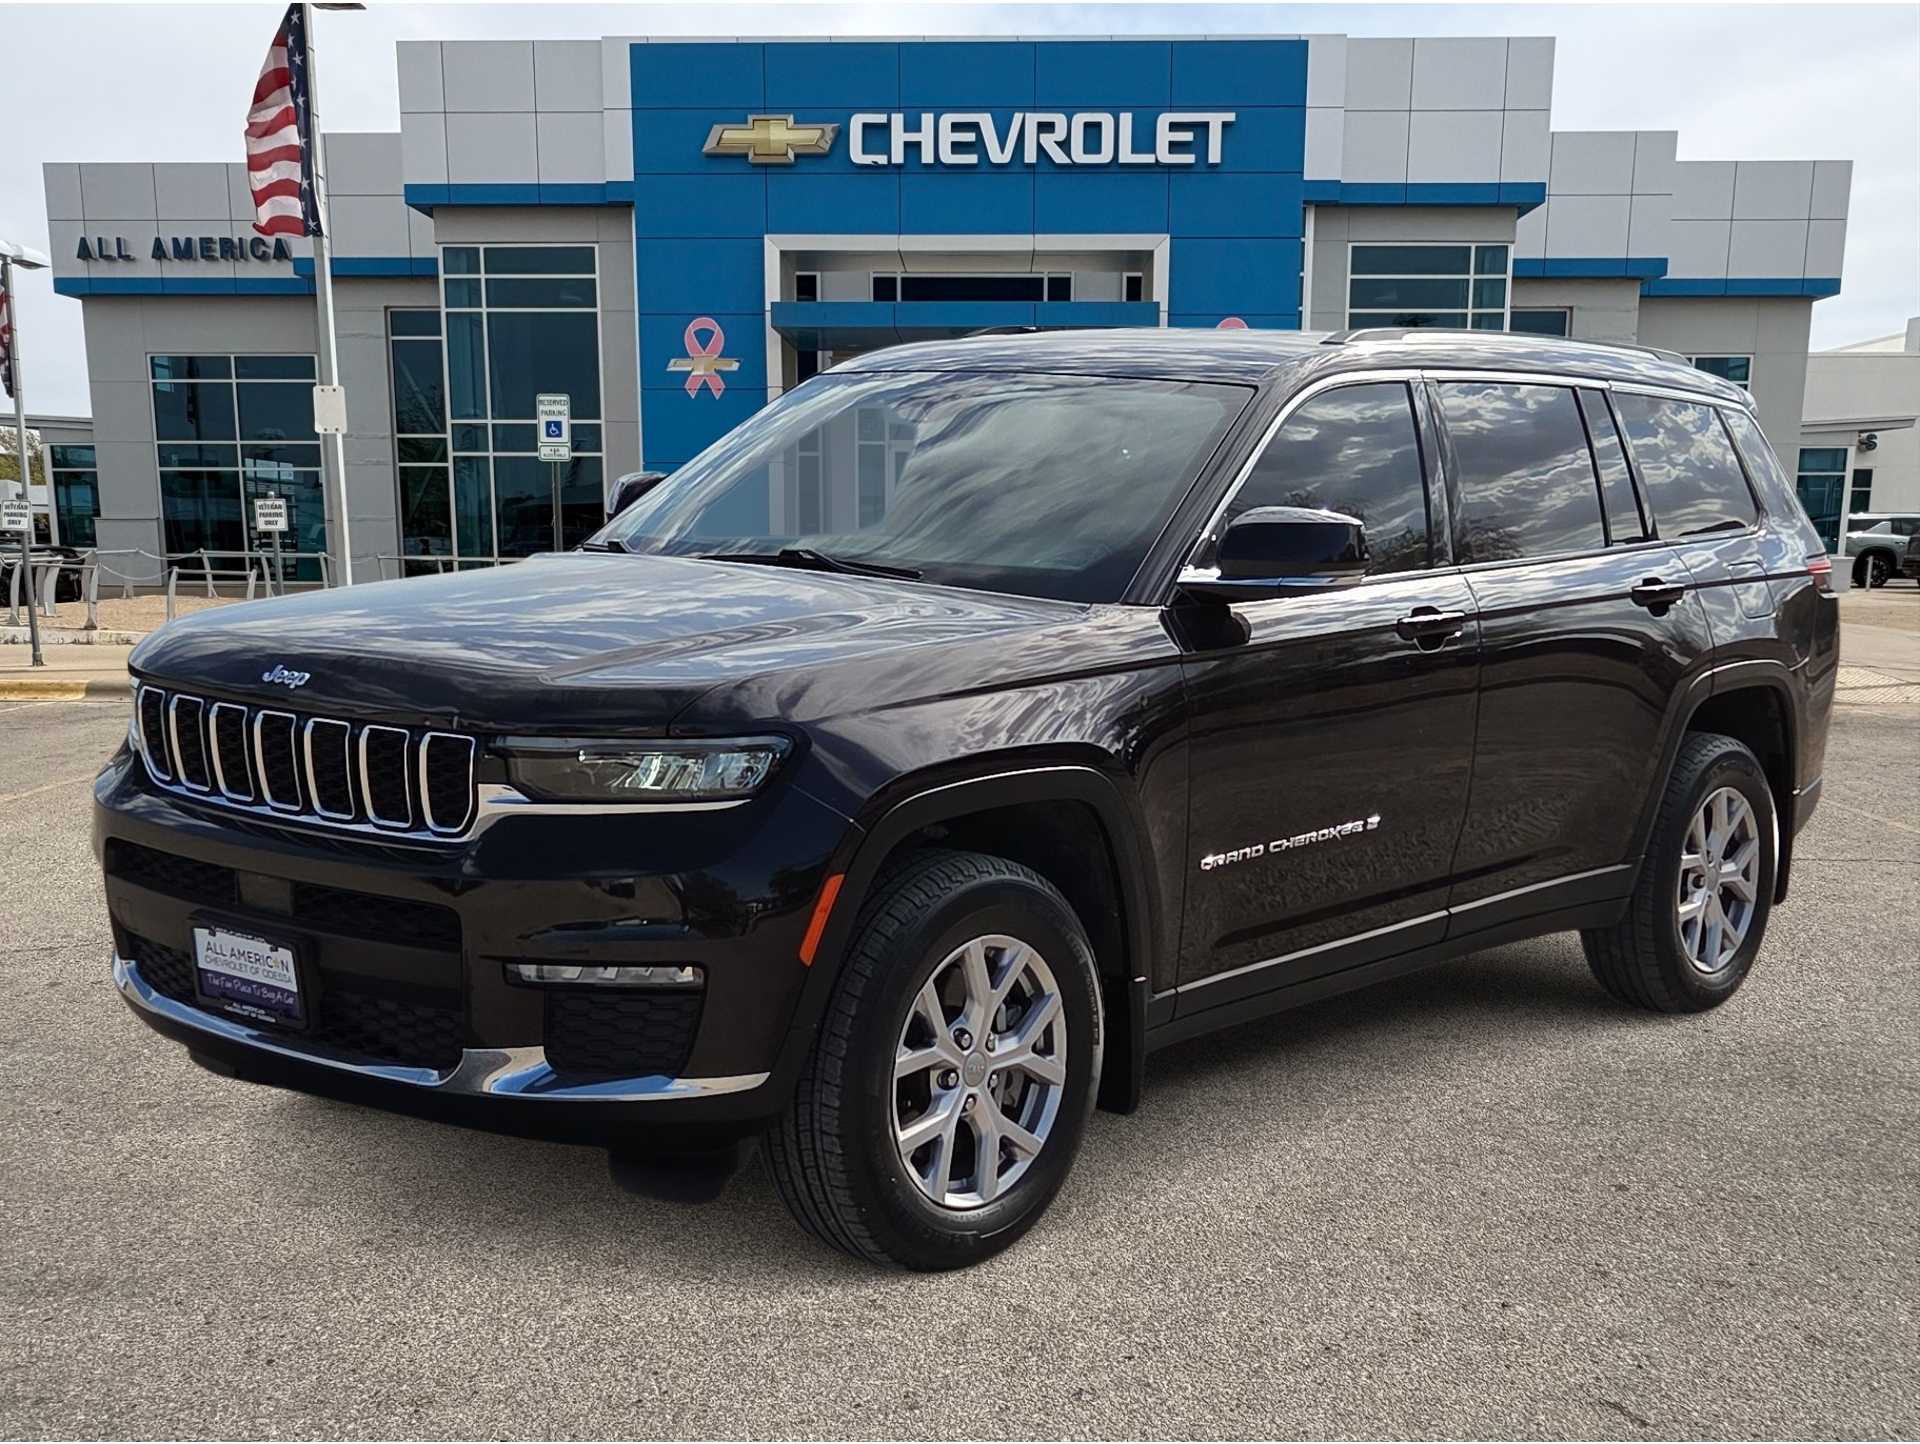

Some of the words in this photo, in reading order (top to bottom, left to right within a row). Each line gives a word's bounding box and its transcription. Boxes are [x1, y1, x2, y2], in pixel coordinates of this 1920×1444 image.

[849, 112, 1236, 166] CHEVROLET
[77, 236, 135, 261] ALL
[262, 664, 311, 689] Jeep
[1200, 844, 1264, 870] GRAND
[1269, 820, 1364, 853] CHEROKEE
[206, 941, 228, 957] ALL
[249, 965, 260, 975] OF
